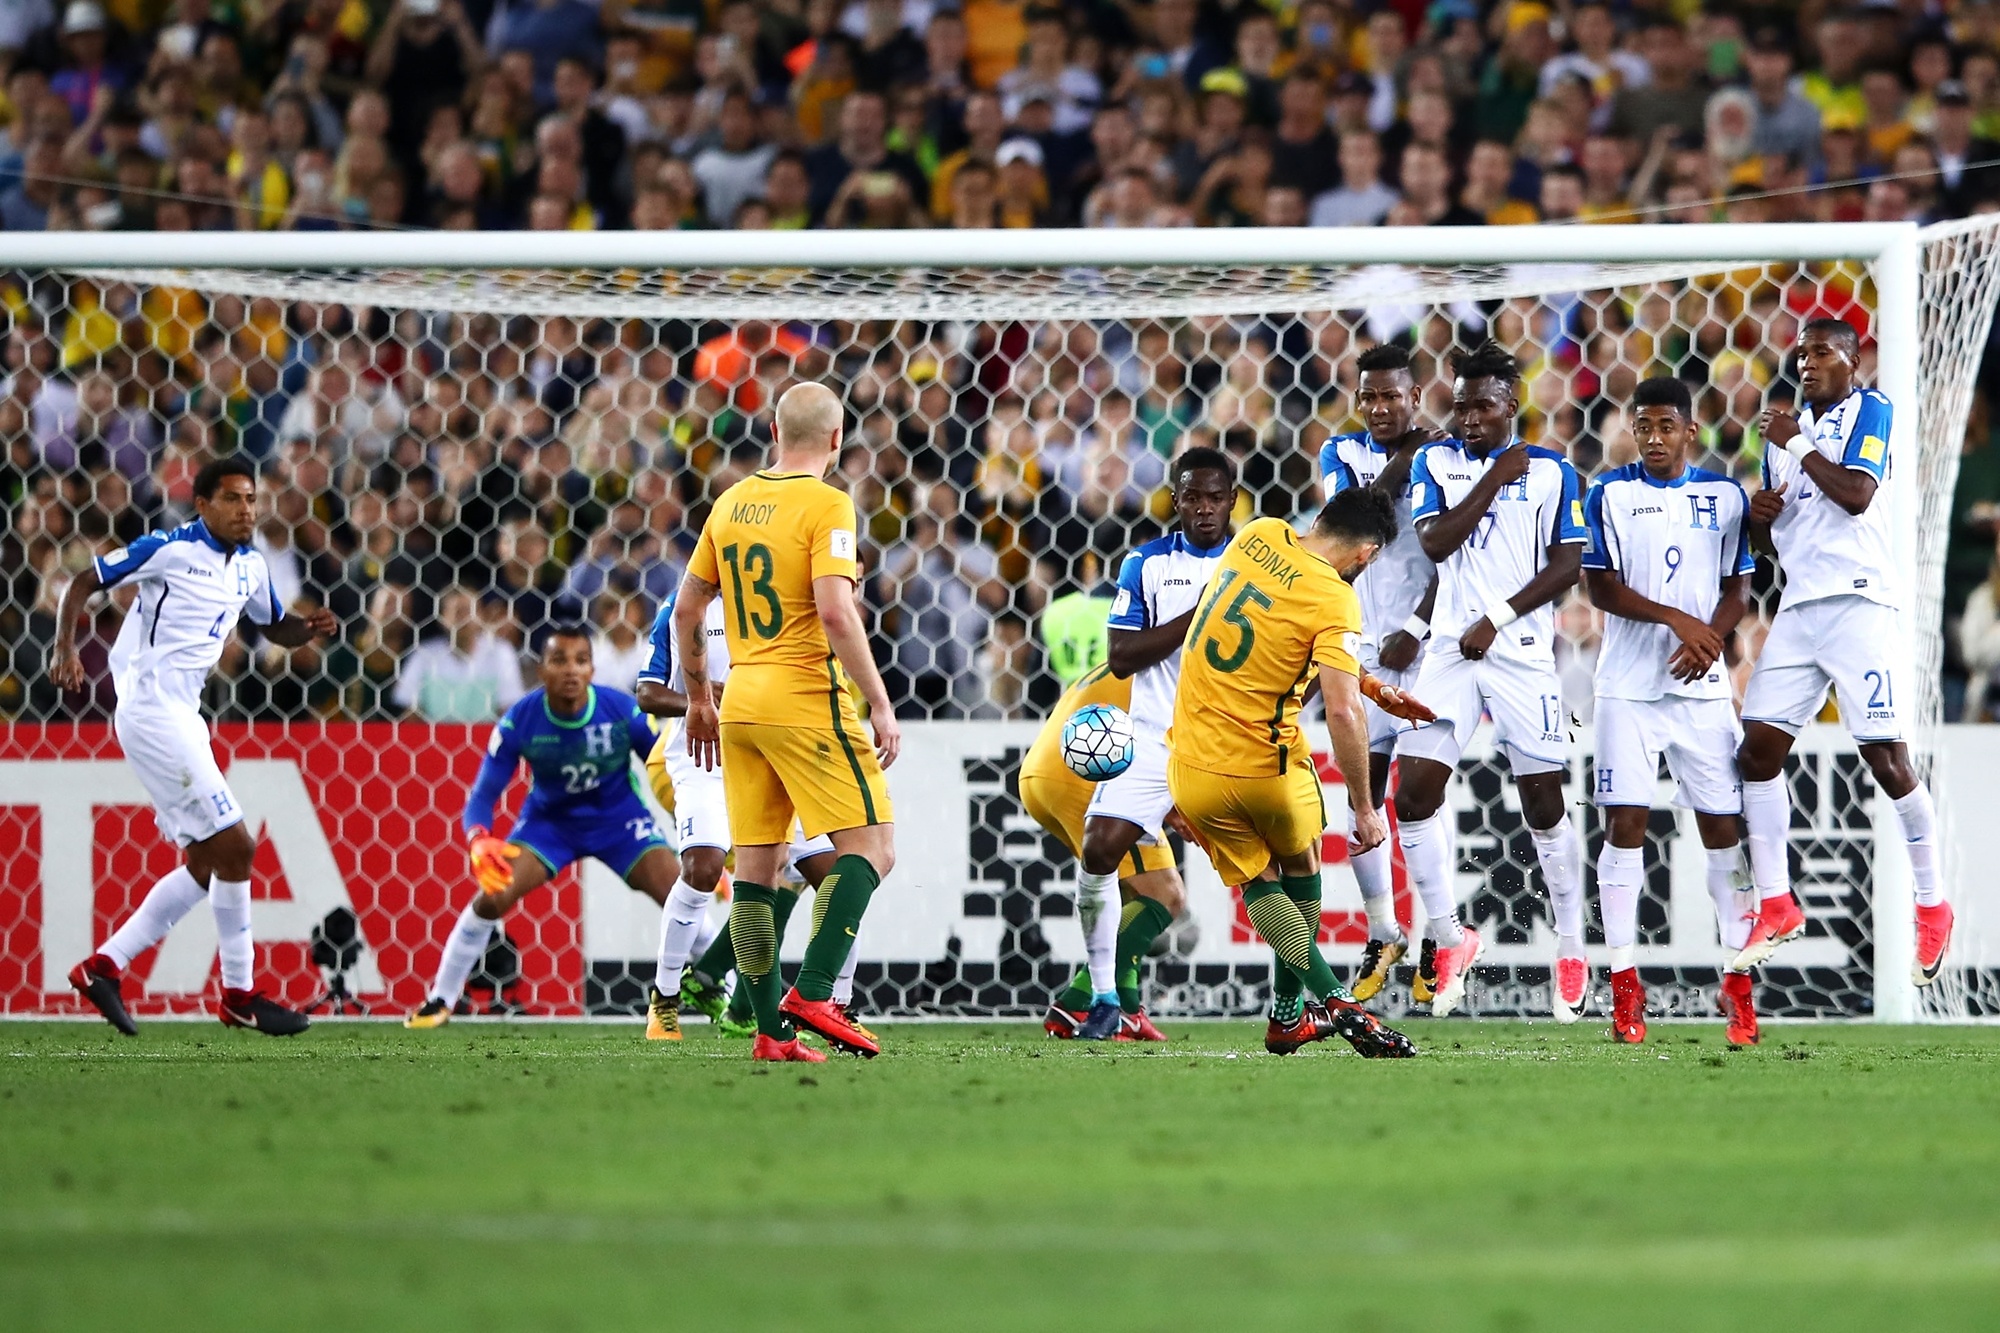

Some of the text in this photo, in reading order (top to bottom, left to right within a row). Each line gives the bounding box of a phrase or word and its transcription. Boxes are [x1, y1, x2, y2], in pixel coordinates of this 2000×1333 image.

[1447, 473, 1472, 481] oma
[730, 502, 776, 525] MOOY
[1686, 494, 1720, 531] H
[235, 562, 250, 597] H
[1239, 534, 1303, 590] JEDINAK
[1665, 545, 1683, 584] 9
[722, 543, 783, 640] 13
[208, 610, 226, 638] 4
[707, 628, 724, 636] om
[1188, 567, 1275, 673] 15
[1864, 669, 1893, 708] 21
[1540, 693, 1560, 733] 17
[583, 722, 614, 757] H
[561, 762, 600, 794] 22
[1597, 768, 1613, 793] H
[211, 790, 233, 817] H
[680, 816, 694, 841] H
